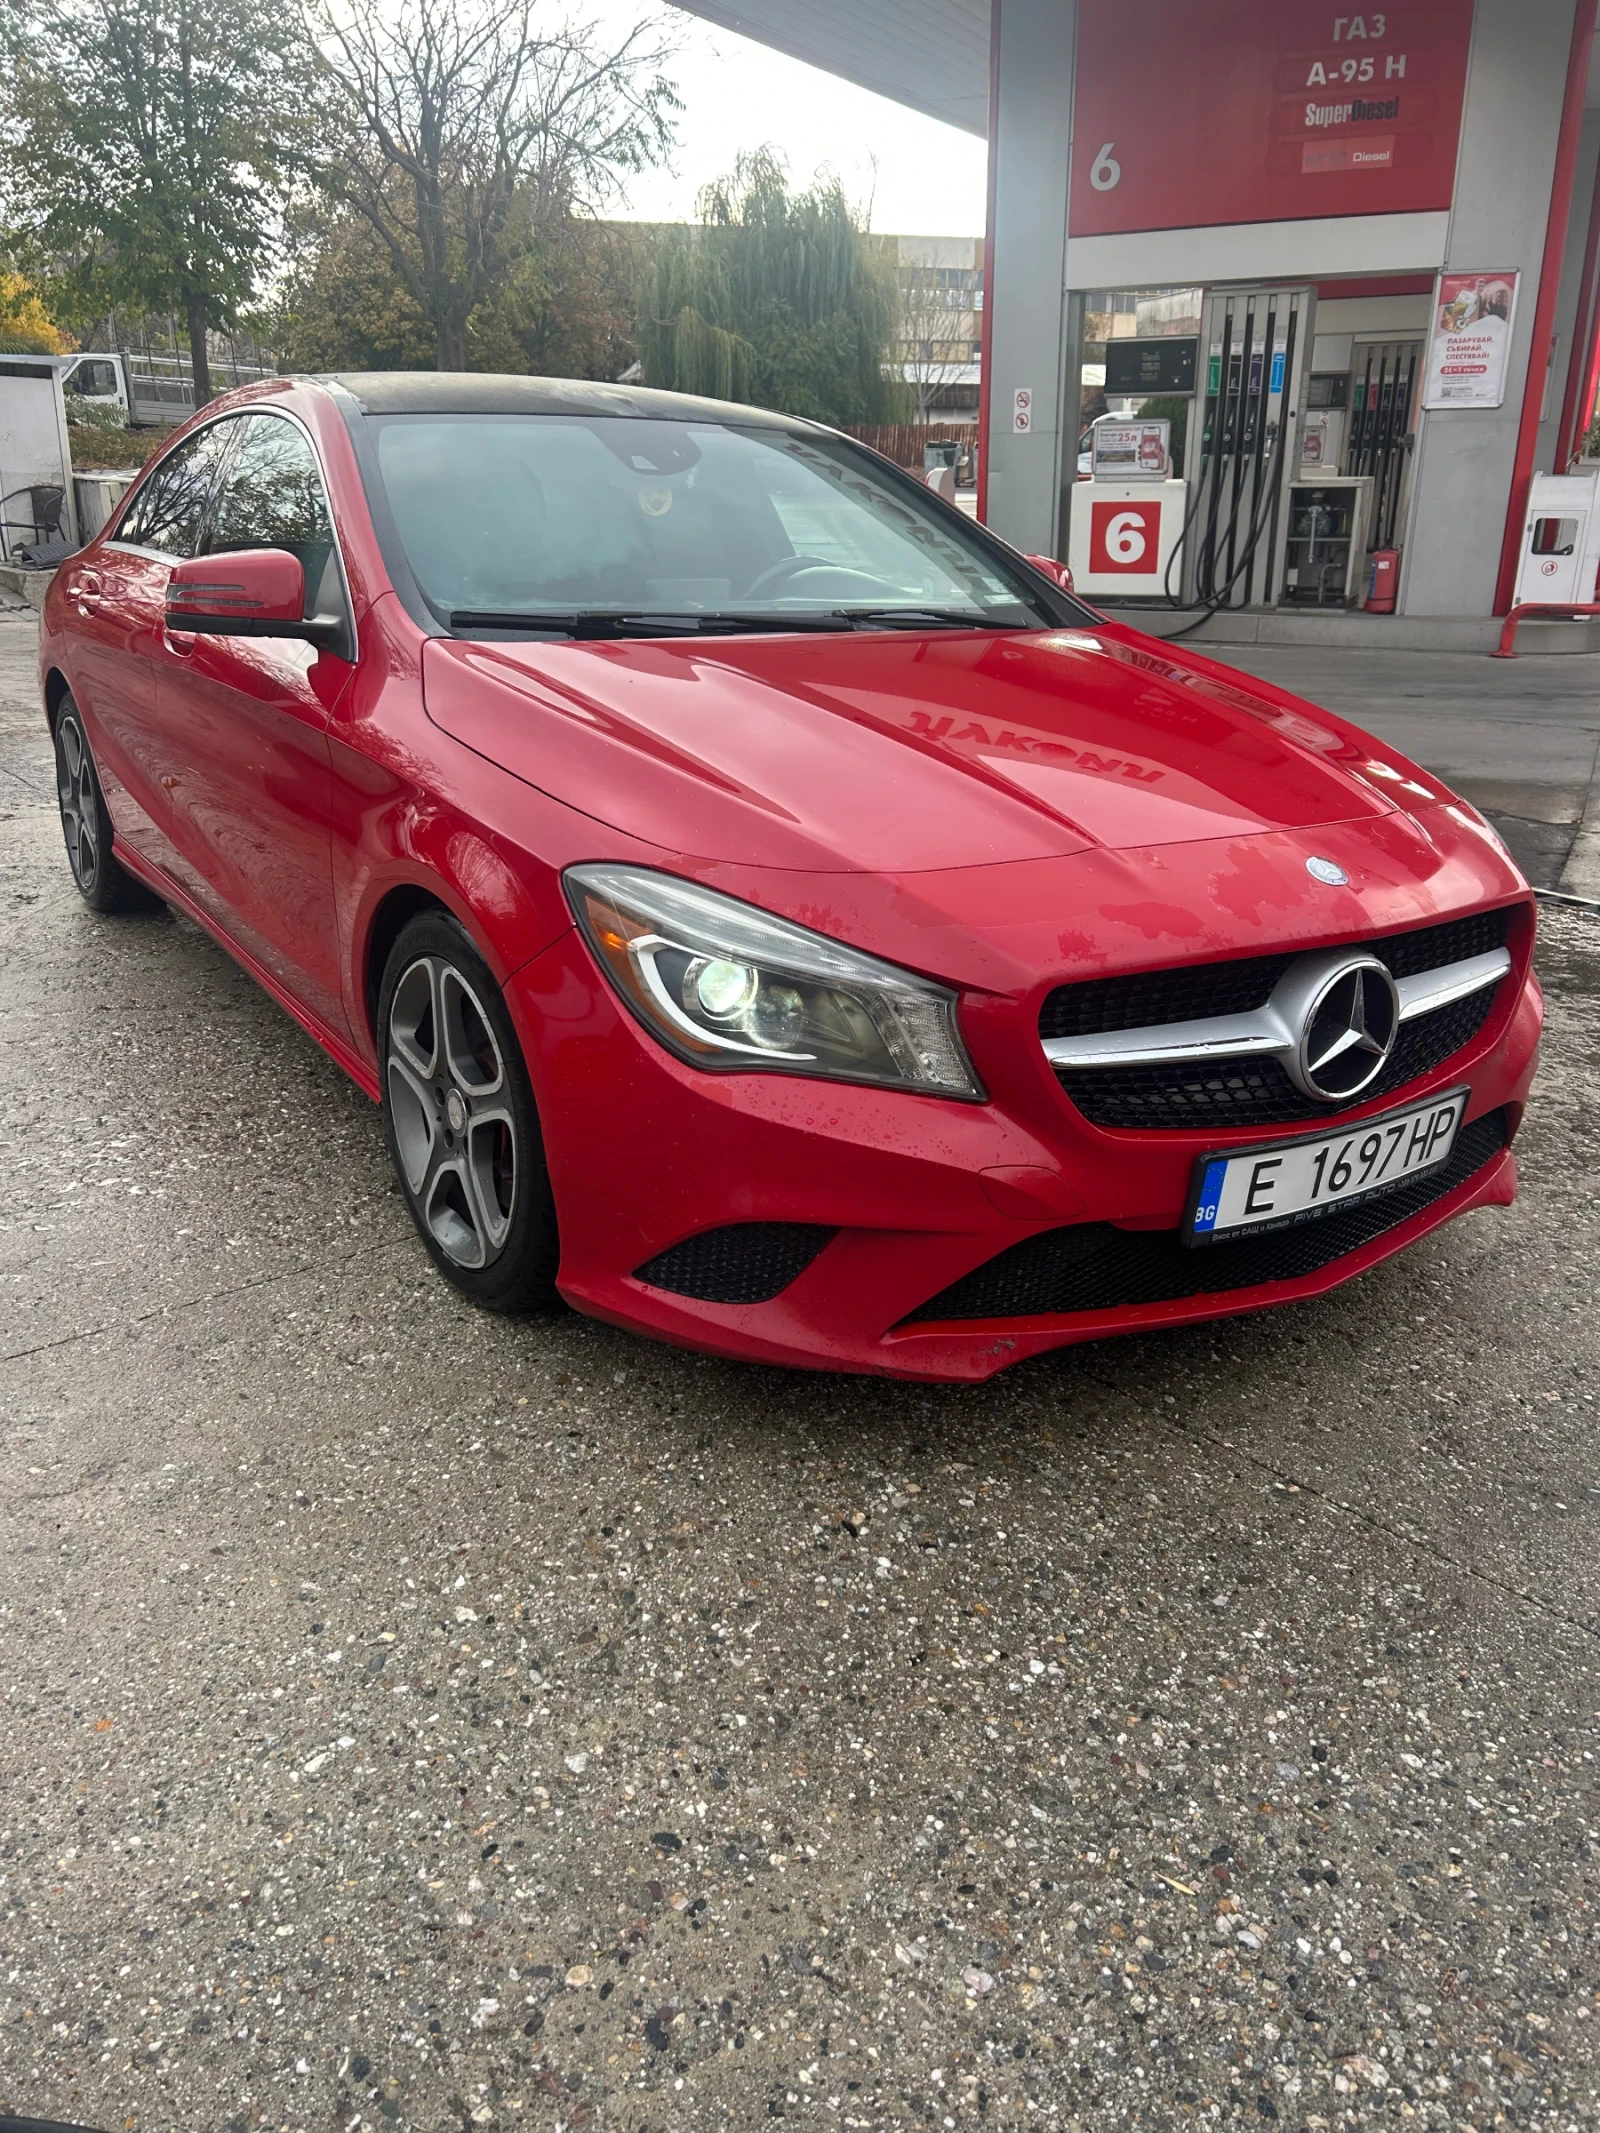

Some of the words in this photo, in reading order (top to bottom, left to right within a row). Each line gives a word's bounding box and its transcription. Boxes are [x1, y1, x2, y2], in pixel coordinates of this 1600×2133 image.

[1333, 13, 1386, 41] ГАЗ
[1306, 57, 1374, 86] А-95
[1305, 96, 1399, 128] SuperDiesel
[1090, 142, 1121, 191] 6
[1352, 150, 1390, 162] Diesel
[1118, 433, 1130, 442] 25
[1105, 511, 1146, 564] 6
[1244, 1158, 1283, 1215] E
[1195, 1205, 1215, 1222] BG
[1294, 1207, 1322, 1223] FIVE
[1328, 1196, 1360, 1213] STAR
[1365, 1183, 1396, 1200] AUTO
[1212, 1233, 1230, 1241] Внос
[1242, 1226, 1260, 1236] САЩ
